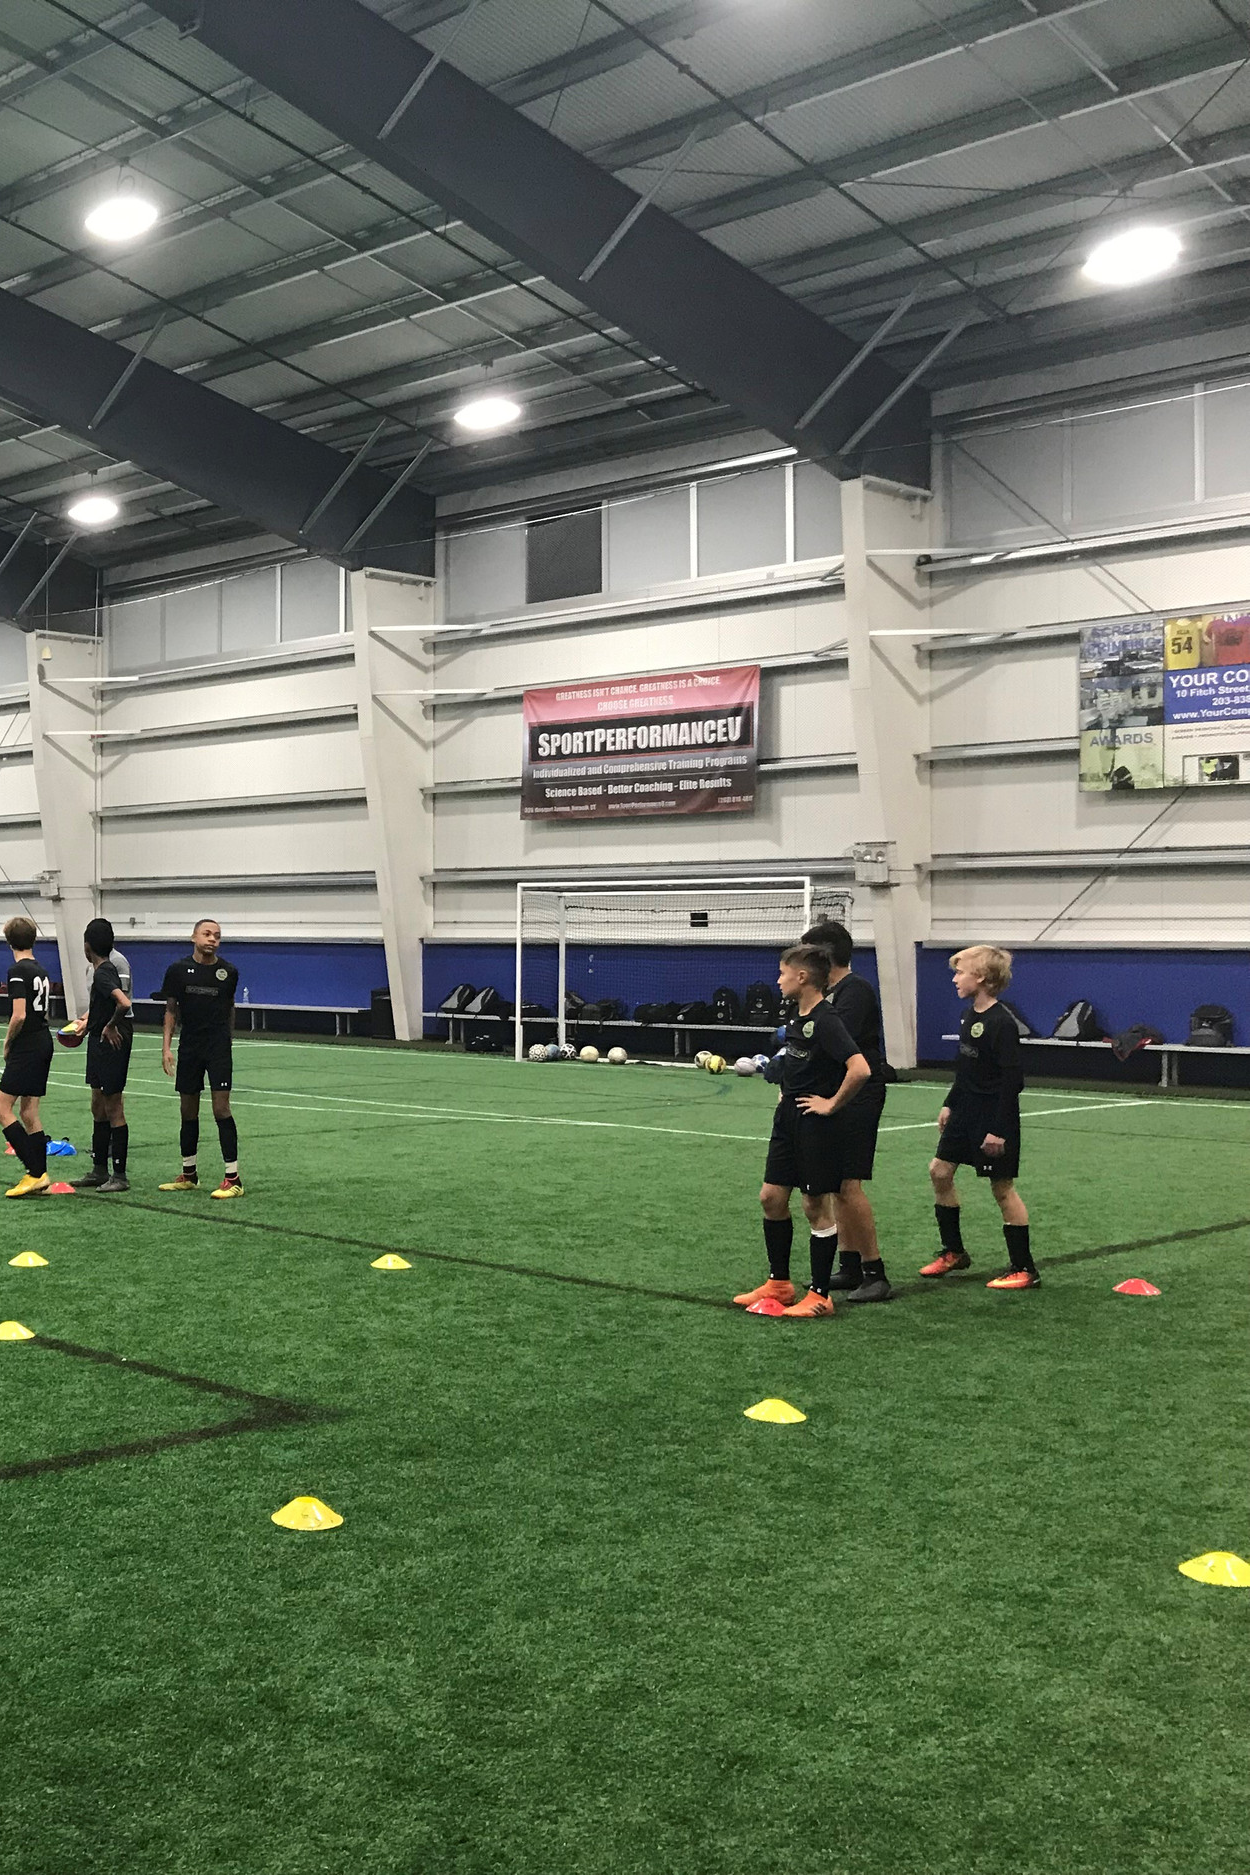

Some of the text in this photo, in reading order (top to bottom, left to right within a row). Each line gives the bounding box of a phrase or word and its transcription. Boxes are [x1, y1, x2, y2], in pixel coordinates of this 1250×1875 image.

[1171, 637, 1193, 655] 54
[1169, 672, 1219, 688] YOUR
[556, 689, 593, 701] GREATNESS
[639, 680, 678, 693] GREATNESS
[679, 679, 687, 689] IS
[687, 678, 693, 688] A
[1176, 689, 1187, 698] 10
[1190, 687, 1216, 698] Fitch
[597, 700, 629, 712] CHOOSE
[1090, 733, 1154, 747] AWARDS
[533, 754, 748, 779] Individualized and Comprehensive Training Programs
[545, 787, 577, 798] Science
[578, 785, 602, 796] Based
[607, 783, 634, 795] Better
[634, 780, 673, 793] Coaching
[679, 779, 698, 790] Elite
[699, 777, 732, 789] Results
[33, 976, 49, 1011] 21
